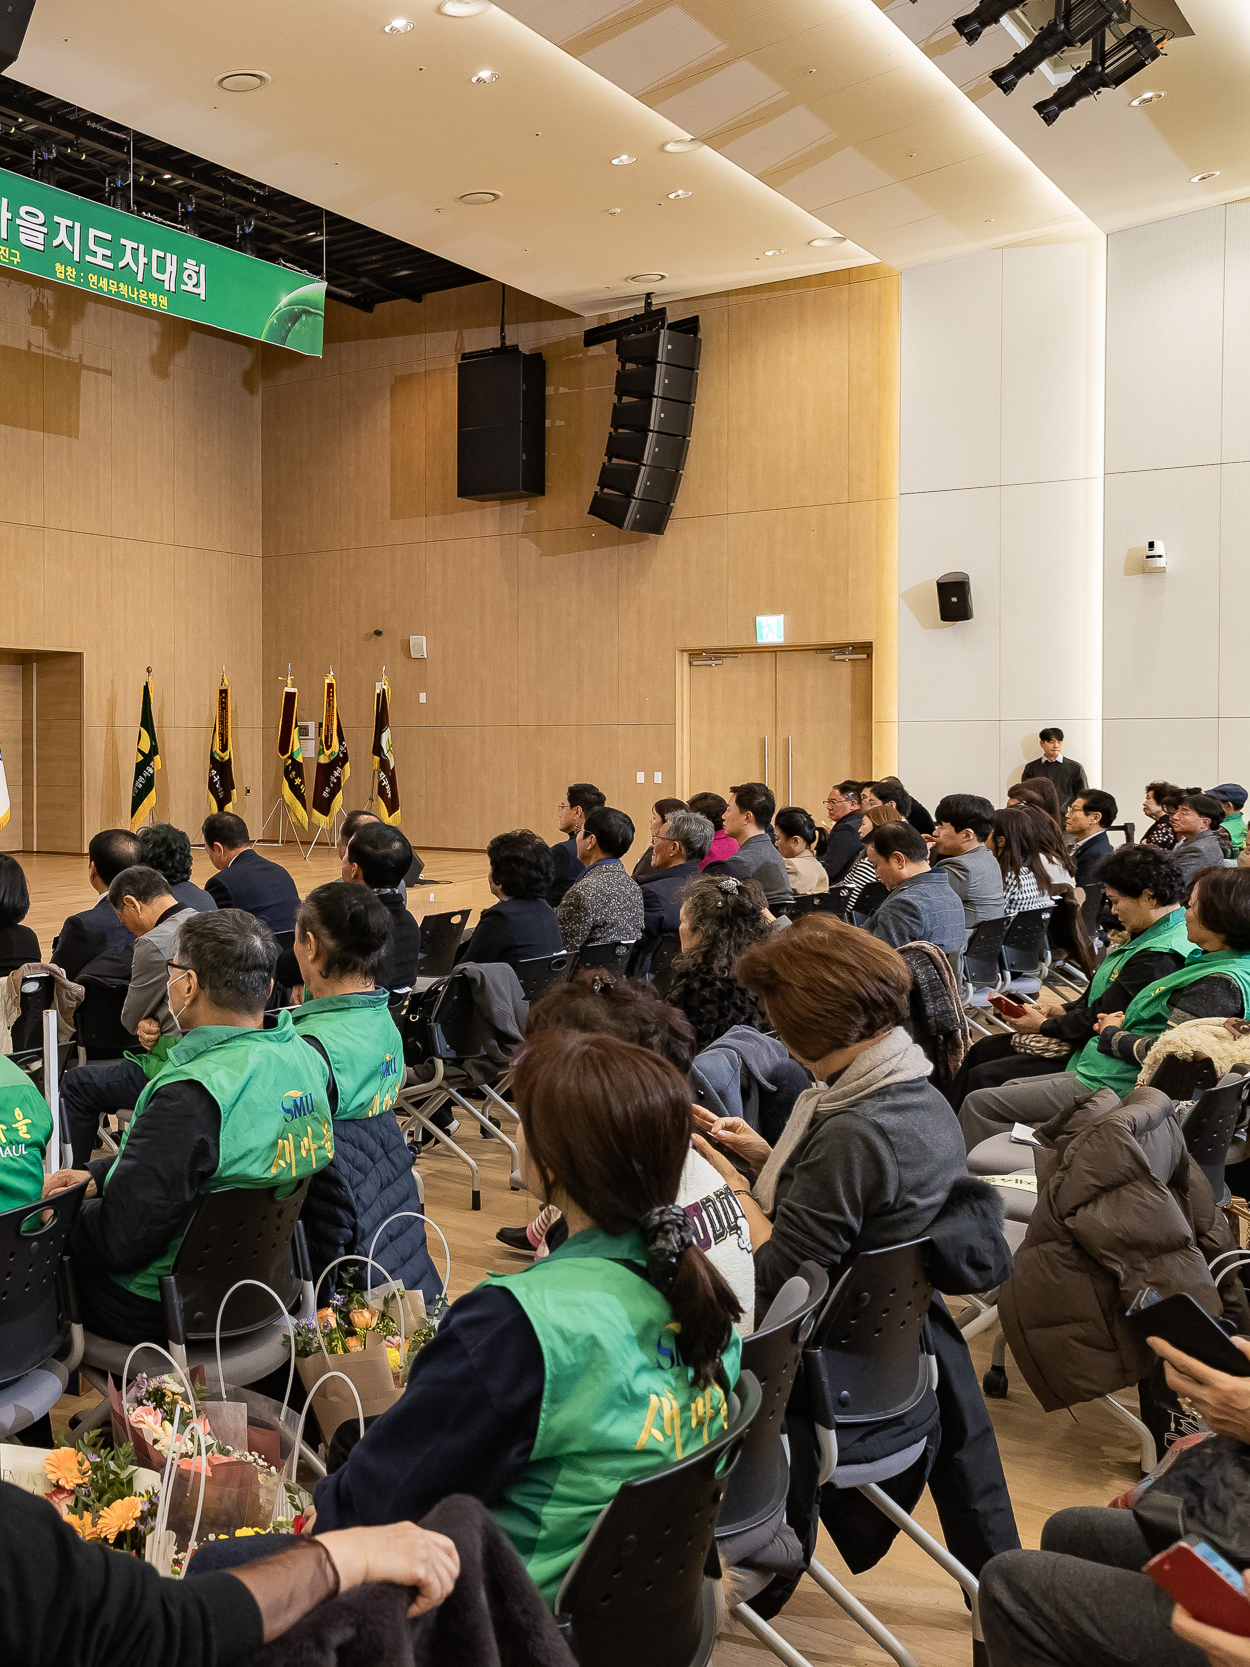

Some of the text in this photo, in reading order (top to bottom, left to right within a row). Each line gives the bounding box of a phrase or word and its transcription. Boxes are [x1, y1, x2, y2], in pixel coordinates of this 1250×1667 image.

[54, 262, 77, 284] 협찬
[87, 272, 169, 310] 연세무척나은병원
[281, 1093, 315, 1122] SMU
[271, 1119, 334, 1177] 새마을
